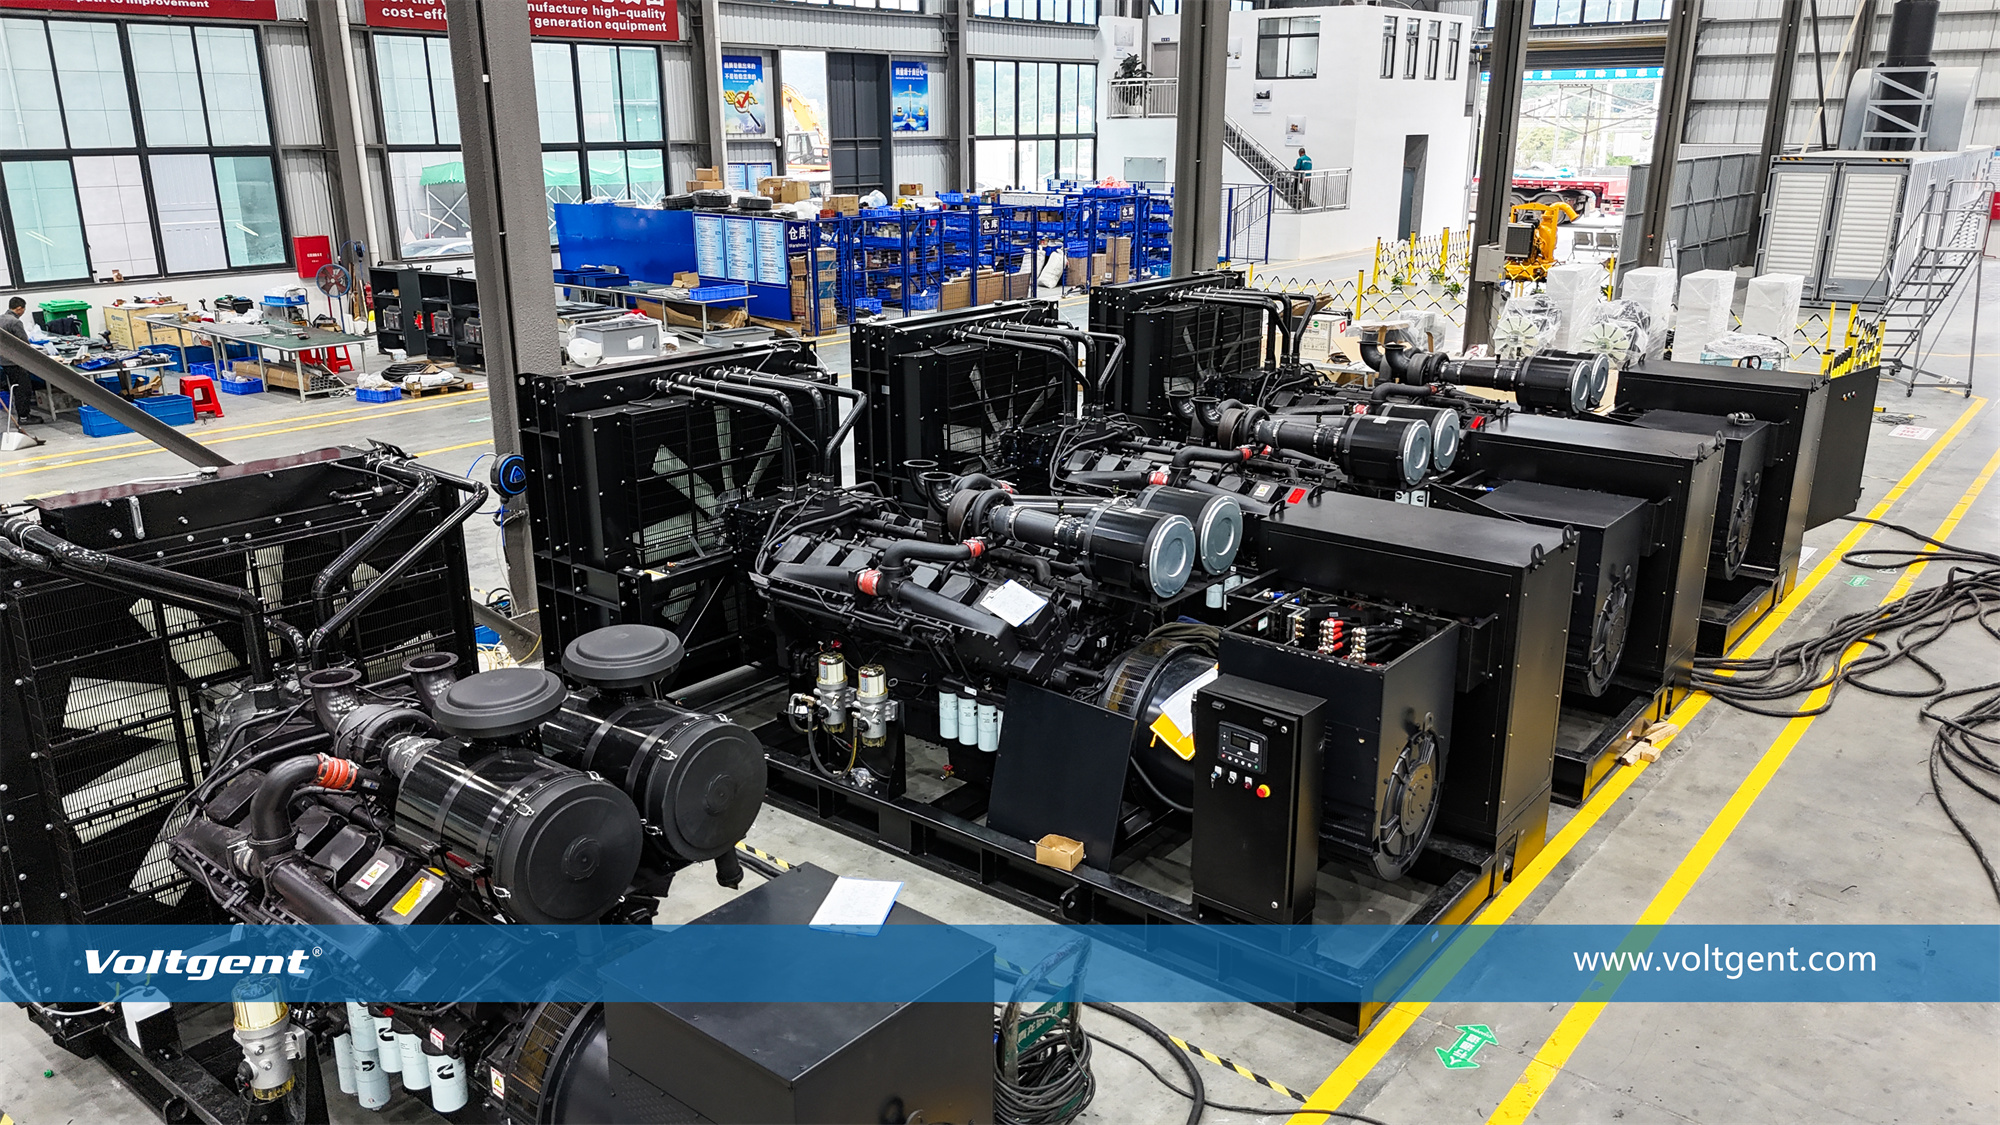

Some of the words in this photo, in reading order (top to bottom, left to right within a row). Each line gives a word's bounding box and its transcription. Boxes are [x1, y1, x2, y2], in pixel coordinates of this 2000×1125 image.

[592, 4, 666, 20] high-quality
[534, 17, 602, 29] generation
[605, 20, 667, 32] equipment
[788, 225, 809, 240] 仓库
